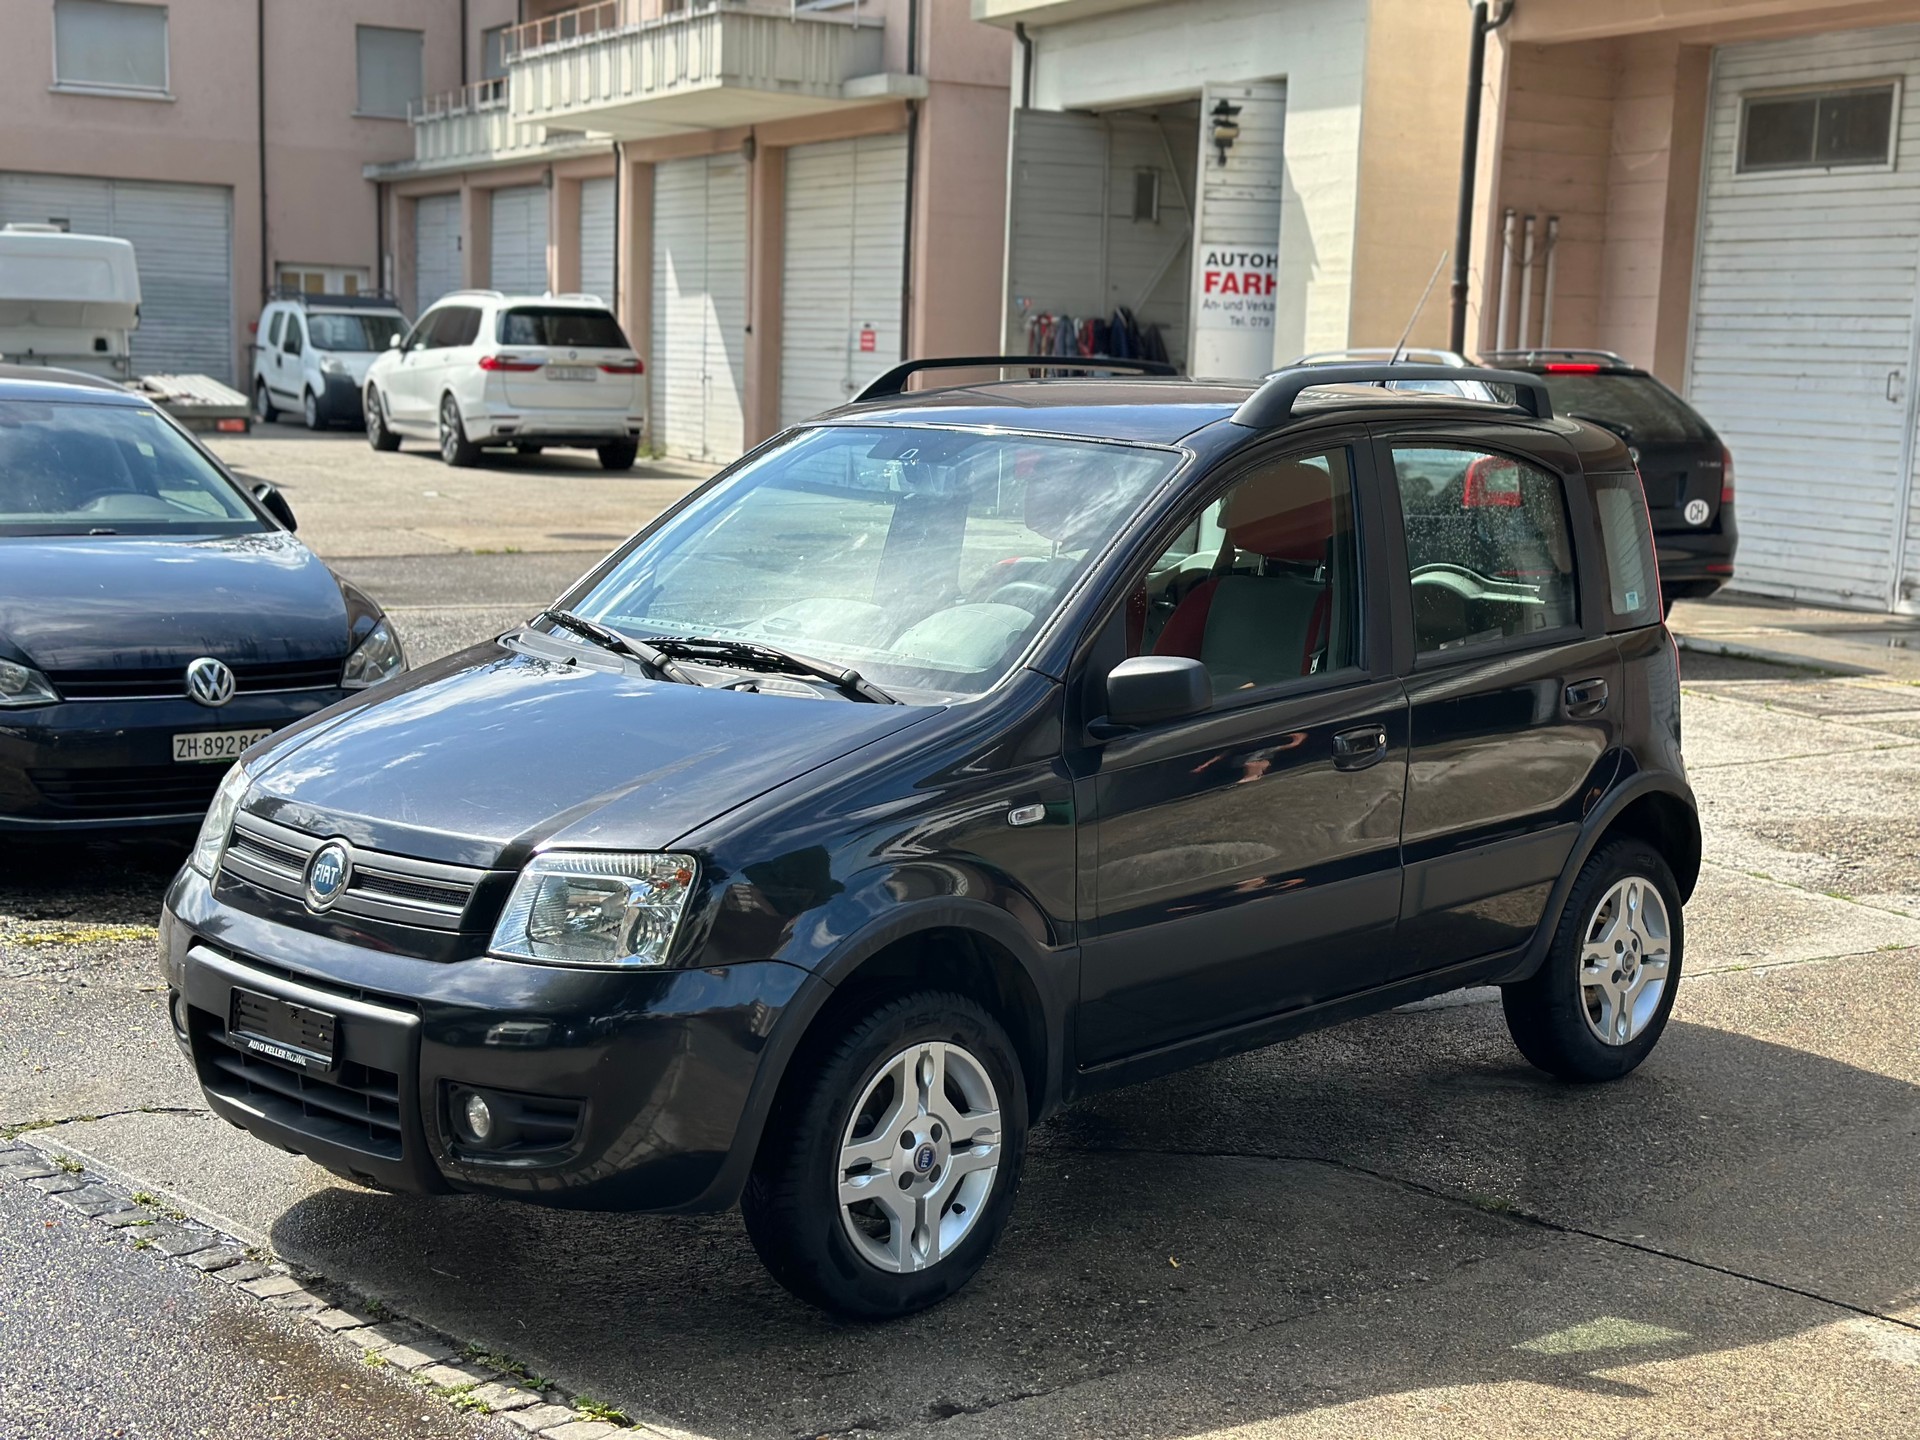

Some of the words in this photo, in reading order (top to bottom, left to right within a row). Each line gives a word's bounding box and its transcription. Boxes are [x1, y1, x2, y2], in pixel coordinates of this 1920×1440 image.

[1224, 301, 1243, 310] und
[1690, 503, 1704, 520] CH
[314, 863, 339, 885] FIAT
[248, 1040, 264, 1051] AUTO
[265, 1044, 286, 1059] KELLER
[921, 1149, 931, 1168] FIAT
